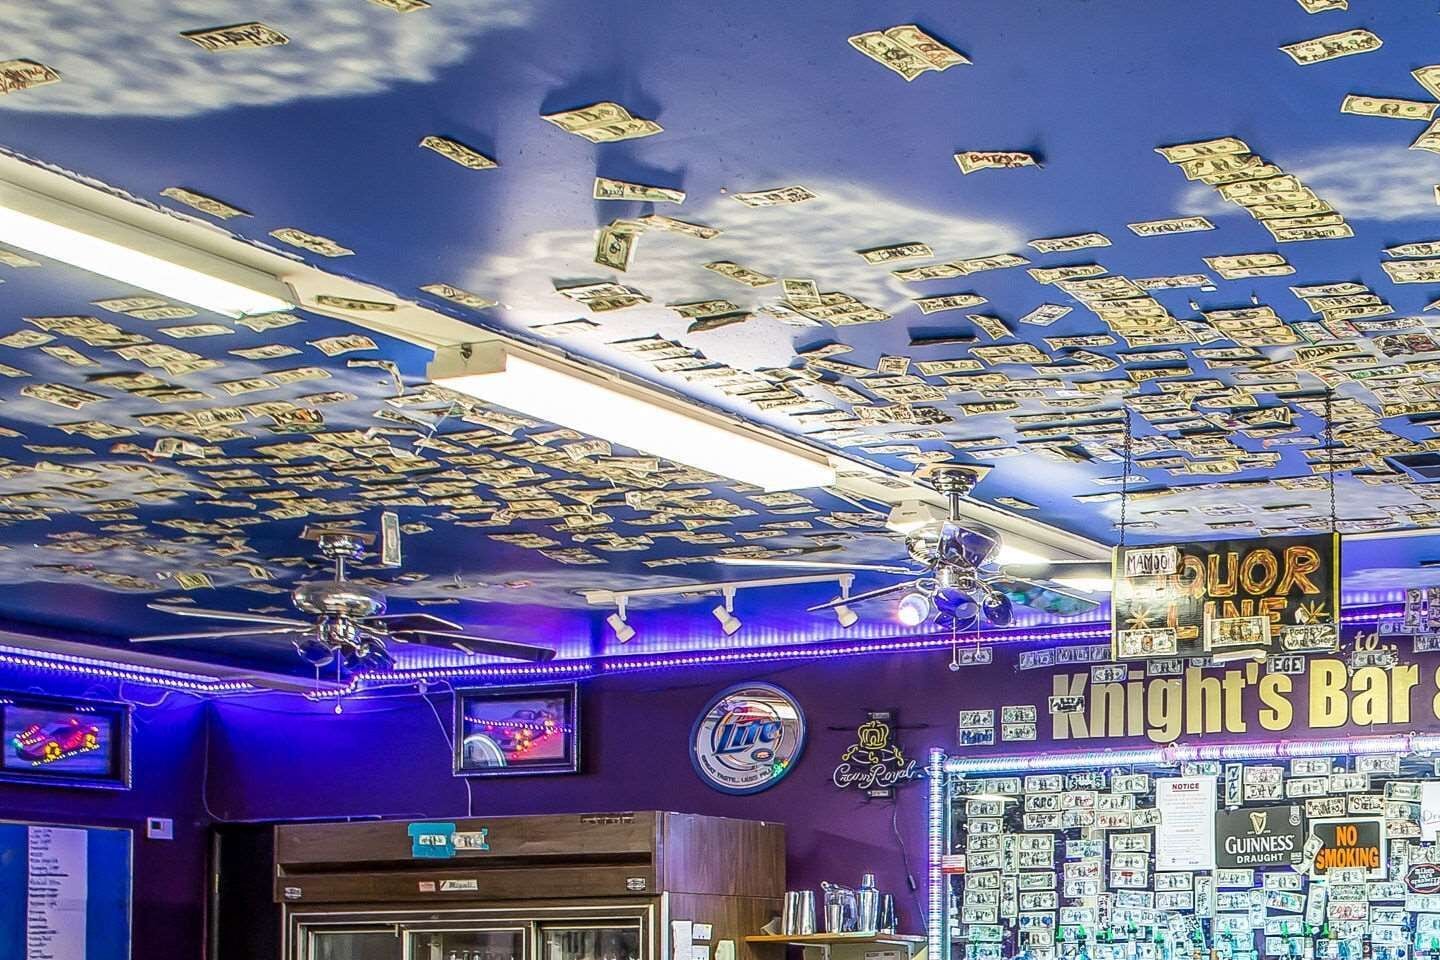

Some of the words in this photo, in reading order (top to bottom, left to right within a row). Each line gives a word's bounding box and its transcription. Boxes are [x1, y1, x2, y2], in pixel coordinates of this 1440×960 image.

[1053, 662, 1293, 743] Knight's
[1309, 659, 1420, 729] Bar
[1172, 783, 1200, 791] NOTICE
[1225, 833, 1295, 854] GUINNESS
[1336, 826, 1357, 846] NO
[1236, 852, 1284, 864] DRAUGHT
[1315, 847, 1379, 869] SMOKING
